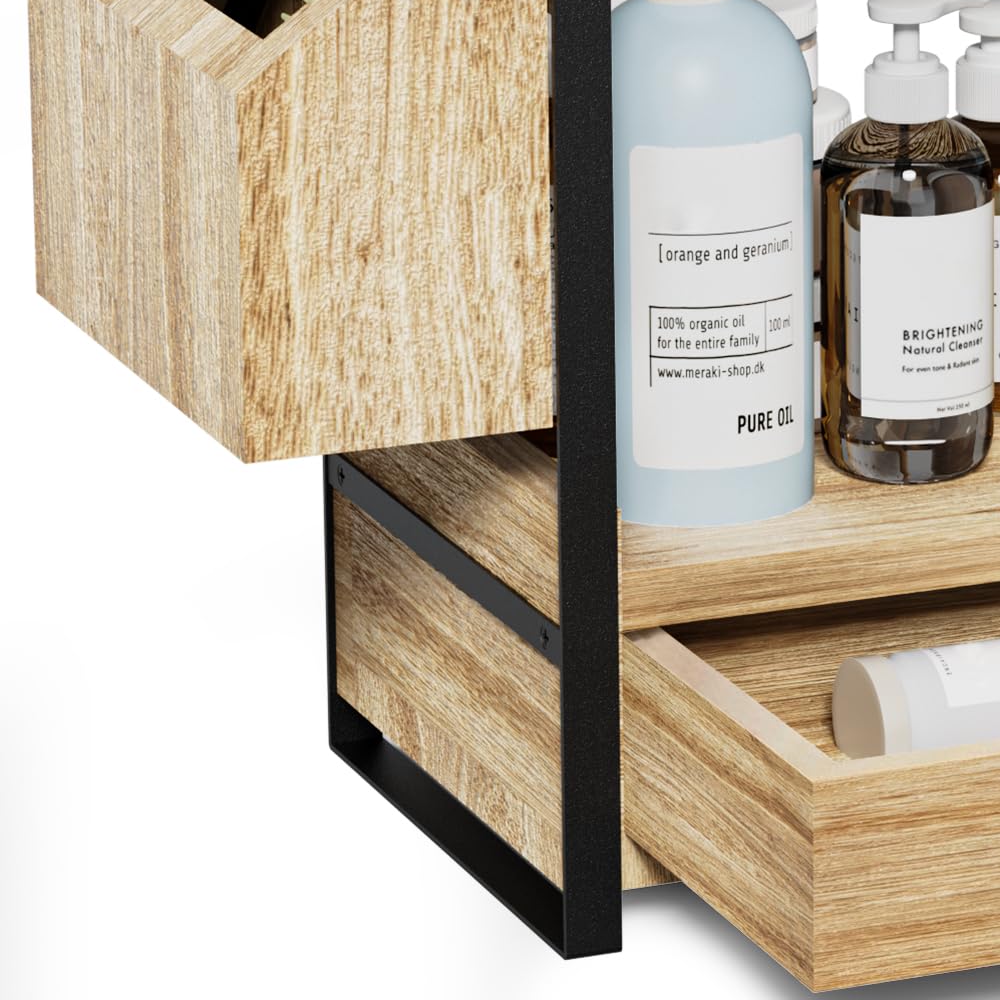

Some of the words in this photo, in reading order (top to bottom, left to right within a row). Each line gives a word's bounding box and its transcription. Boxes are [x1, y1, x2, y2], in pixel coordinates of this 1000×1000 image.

[715, 244, 738, 261] and
[657, 316, 686, 330] 100%
[689, 316, 729, 332] organic
[732, 314, 745, 328] oil
[768, 318, 782, 332] 100
[782, 315, 791, 329] ml
[903, 319, 984, 342] BRIGHTENING
[657, 336, 671, 349] for
[675, 337, 692, 349] the
[695, 336, 726, 350] entire
[729, 333, 760, 348] family
[903, 342, 945, 355] Natural
[949, 336, 984, 352] Cleanser
[657, 361, 765, 379] www.meraki-shop.dk
[902, 365, 914, 374] For
[737, 410, 773, 434] PURE
[778, 404, 794, 427] OIL
